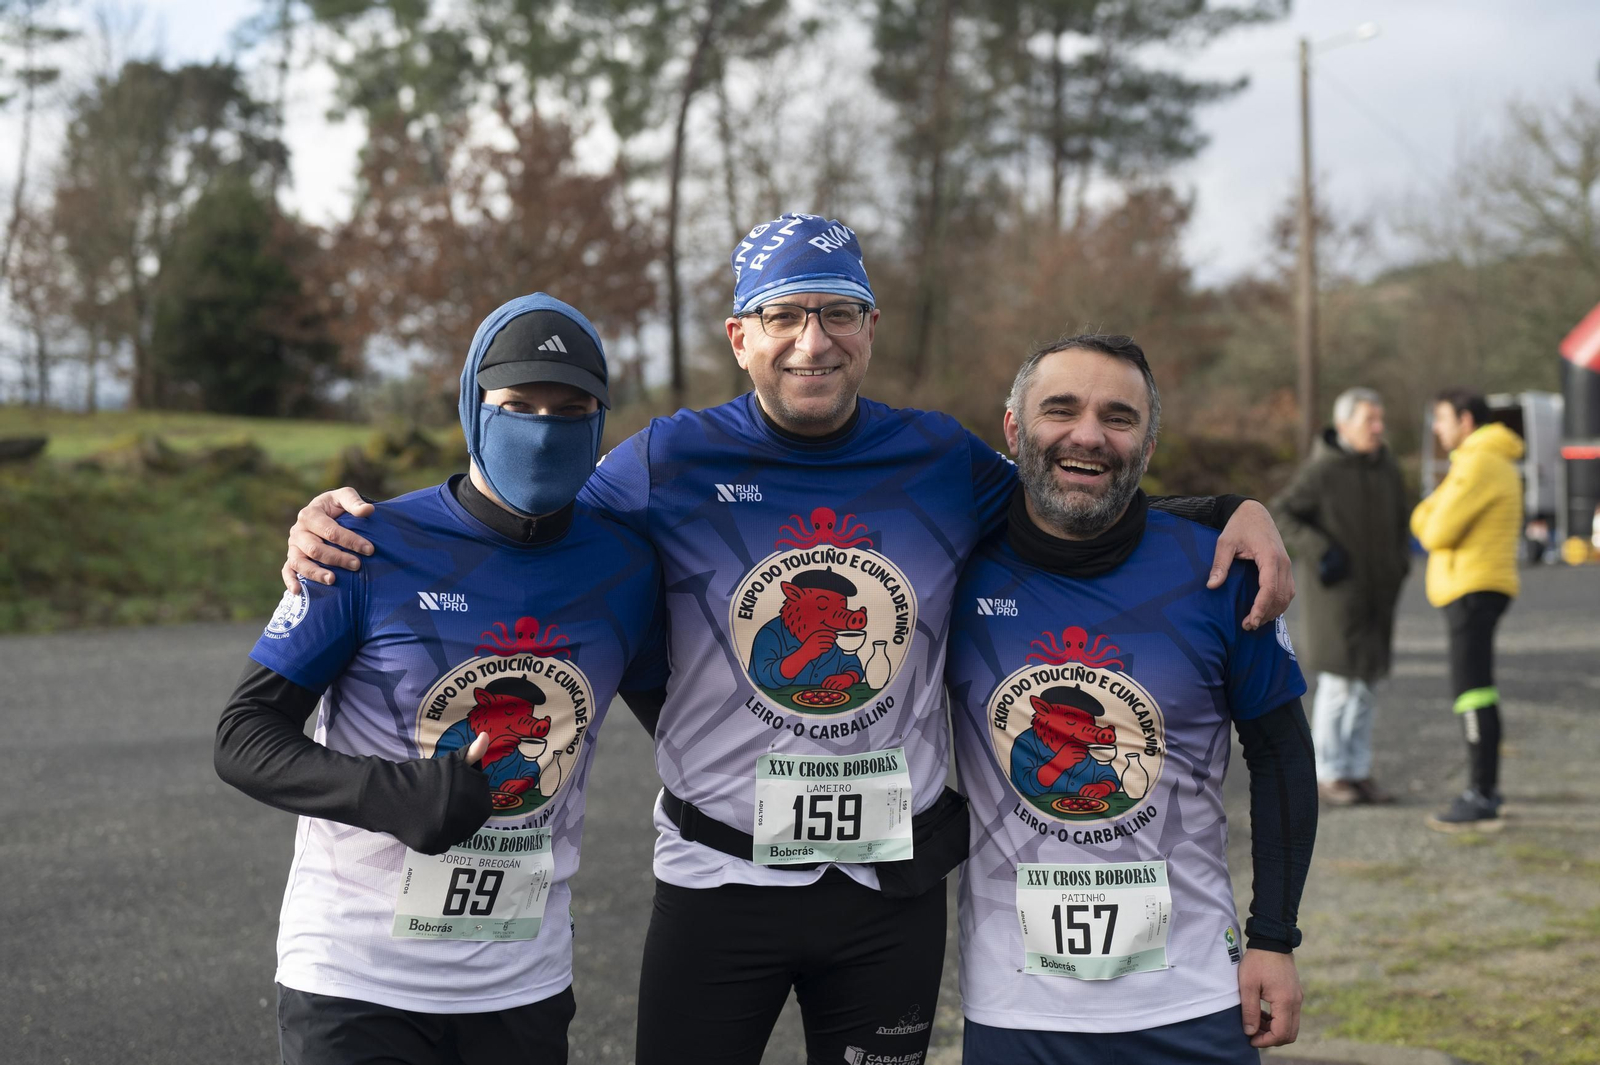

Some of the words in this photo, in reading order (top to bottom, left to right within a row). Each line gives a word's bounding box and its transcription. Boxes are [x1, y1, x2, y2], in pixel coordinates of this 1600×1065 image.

[736, 484, 758, 493] RUN
[740, 492, 762, 502] PRO
[738, 581, 765, 620] EKIPO
[766, 564, 782, 584] DO
[780, 548, 848, 568] TOUCIÑO
[849, 554, 860, 568] E
[440, 592, 464, 602] RUN
[443, 602, 468, 612] PRO
[994, 598, 1016, 608] RUN
[996, 606, 1018, 616] PRO
[426, 686, 457, 722] EKIPO
[454, 670, 478, 690] DO
[478, 656, 544, 678] TOUCIÑO
[544, 664, 556, 678] E
[994, 693, 1015, 731] EKIPO
[1010, 678, 1032, 698] DO
[1030, 666, 1097, 686] TOUCIÑO
[1098, 675, 1110, 690] E
[745, 696, 784, 730] LEIRO
[793, 722, 804, 736] O
[809, 696, 895, 740] CARBALLIÑO
[768, 759, 795, 776] XXV
[799, 762, 839, 778] CROSS
[842, 753, 898, 777] BOBORÁS
[806, 784, 852, 793] LAMEIRO
[792, 794, 862, 840] 159
[1013, 802, 1048, 836] LEIRO
[1058, 828, 1068, 842] O
[1073, 805, 1158, 844] CARBALLIÑO
[499, 830, 544, 852] BOBORÁS
[440, 854, 473, 866] JORDI
[478, 858, 521, 868] BREOGÁN
[403, 867, 413, 894] ADULTOS
[1027, 870, 1049, 886] XXV
[1054, 870, 1091, 886] CROSS
[1096, 865, 1156, 886] BOBORÁS
[442, 868, 504, 916] 69
[1062, 894, 1106, 903] PATINHO
[1052, 904, 1118, 955] 157
[866, 1050, 922, 1062] CABALEIRO
